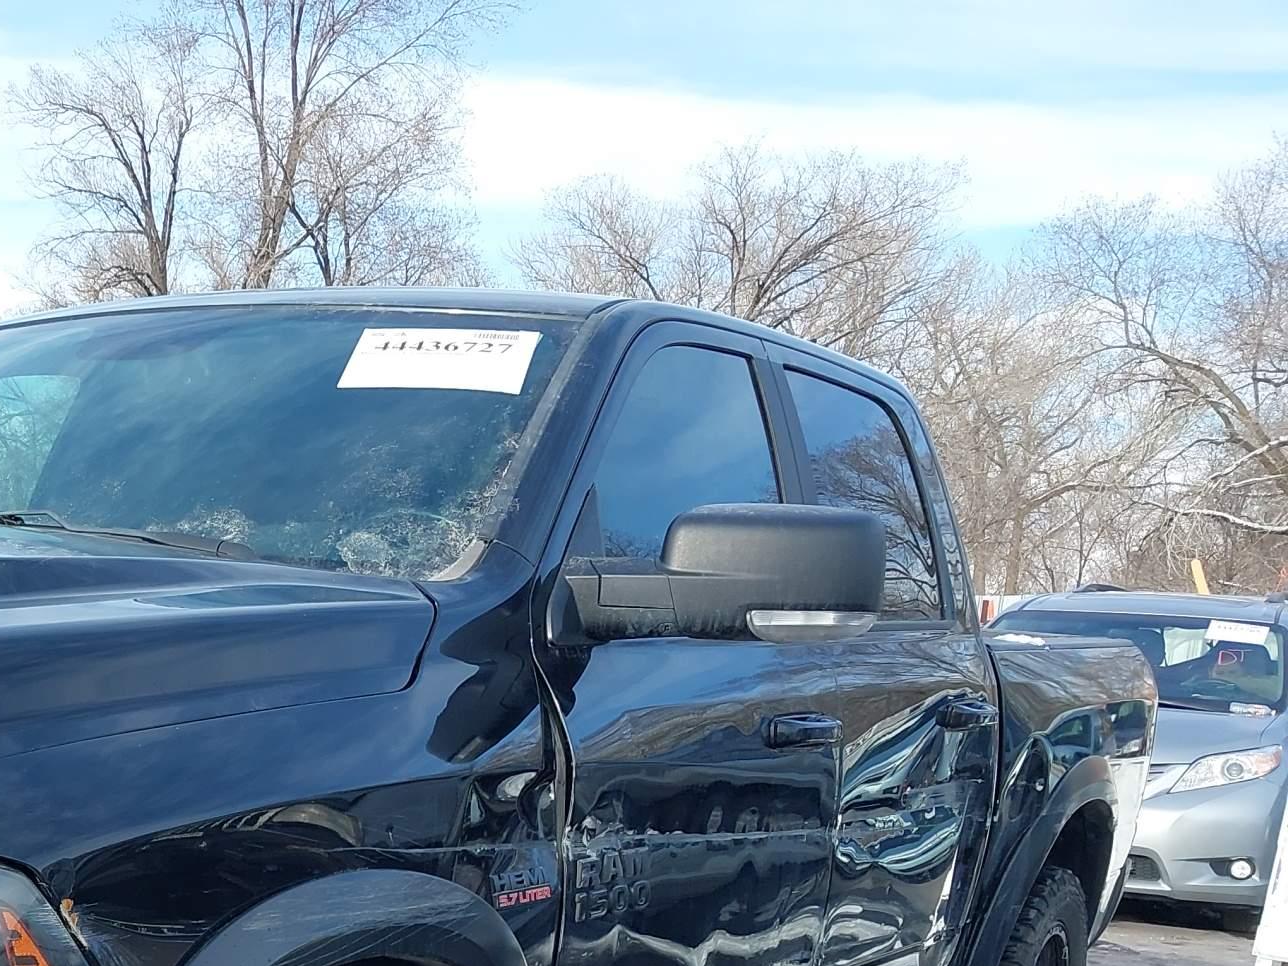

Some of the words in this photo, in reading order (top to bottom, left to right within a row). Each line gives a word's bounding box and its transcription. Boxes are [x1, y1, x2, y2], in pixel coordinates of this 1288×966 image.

[374, 340, 514, 354] 44436727
[576, 851, 646, 889] RAM
[519, 886, 552, 904] LITER
[574, 880, 650, 924] 1500
